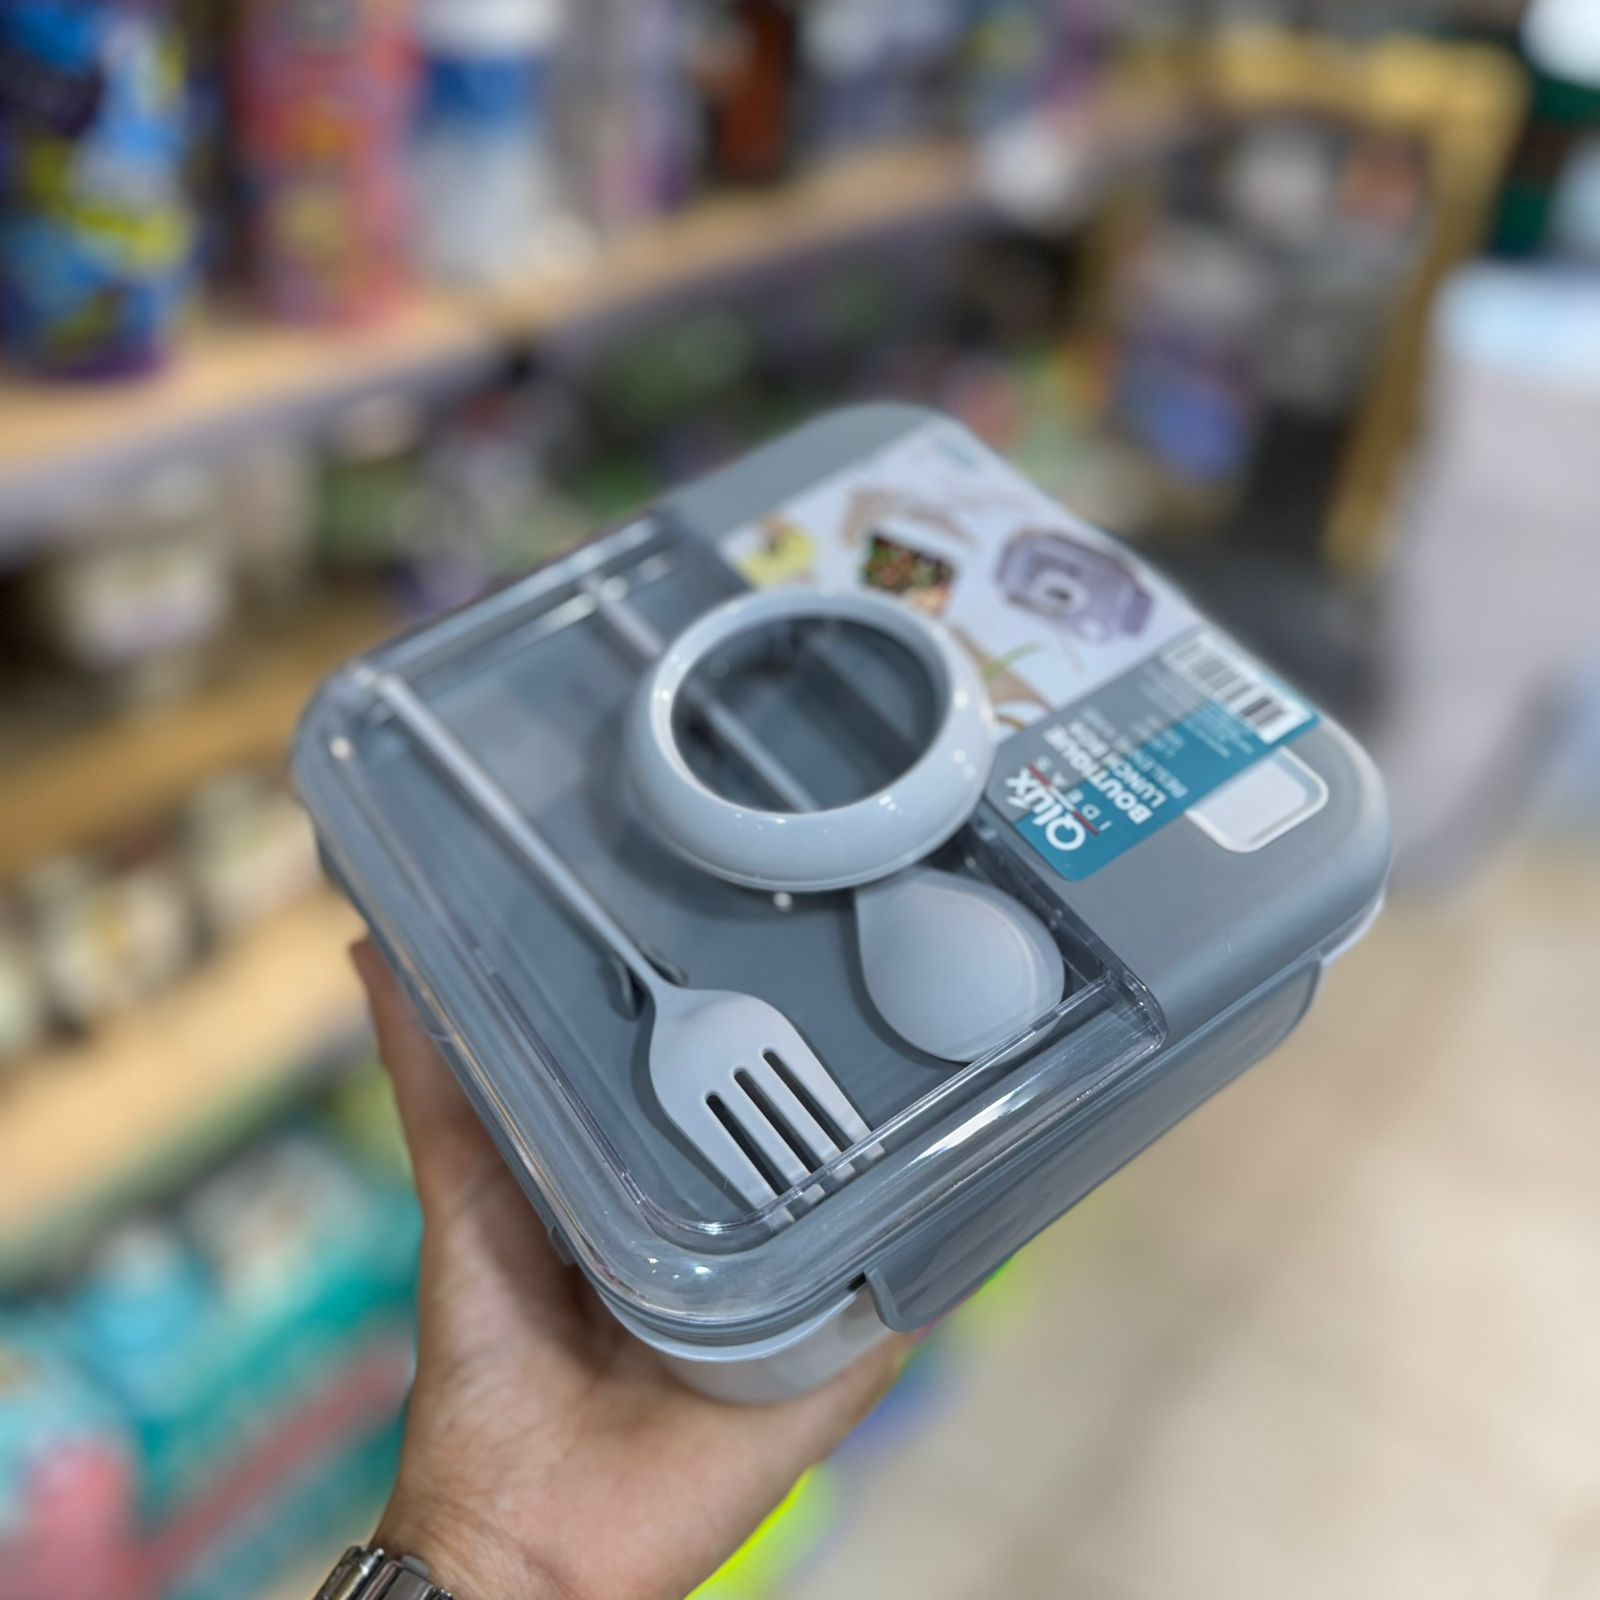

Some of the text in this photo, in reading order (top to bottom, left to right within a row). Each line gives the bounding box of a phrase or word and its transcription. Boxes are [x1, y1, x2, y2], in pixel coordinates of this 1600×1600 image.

[1065, 717, 1110, 757] BOX
[1033, 755, 1112, 831] IDEAS
[1043, 722, 1153, 825] BOUTIQUE
[1101, 752, 1167, 807] LUNCH
